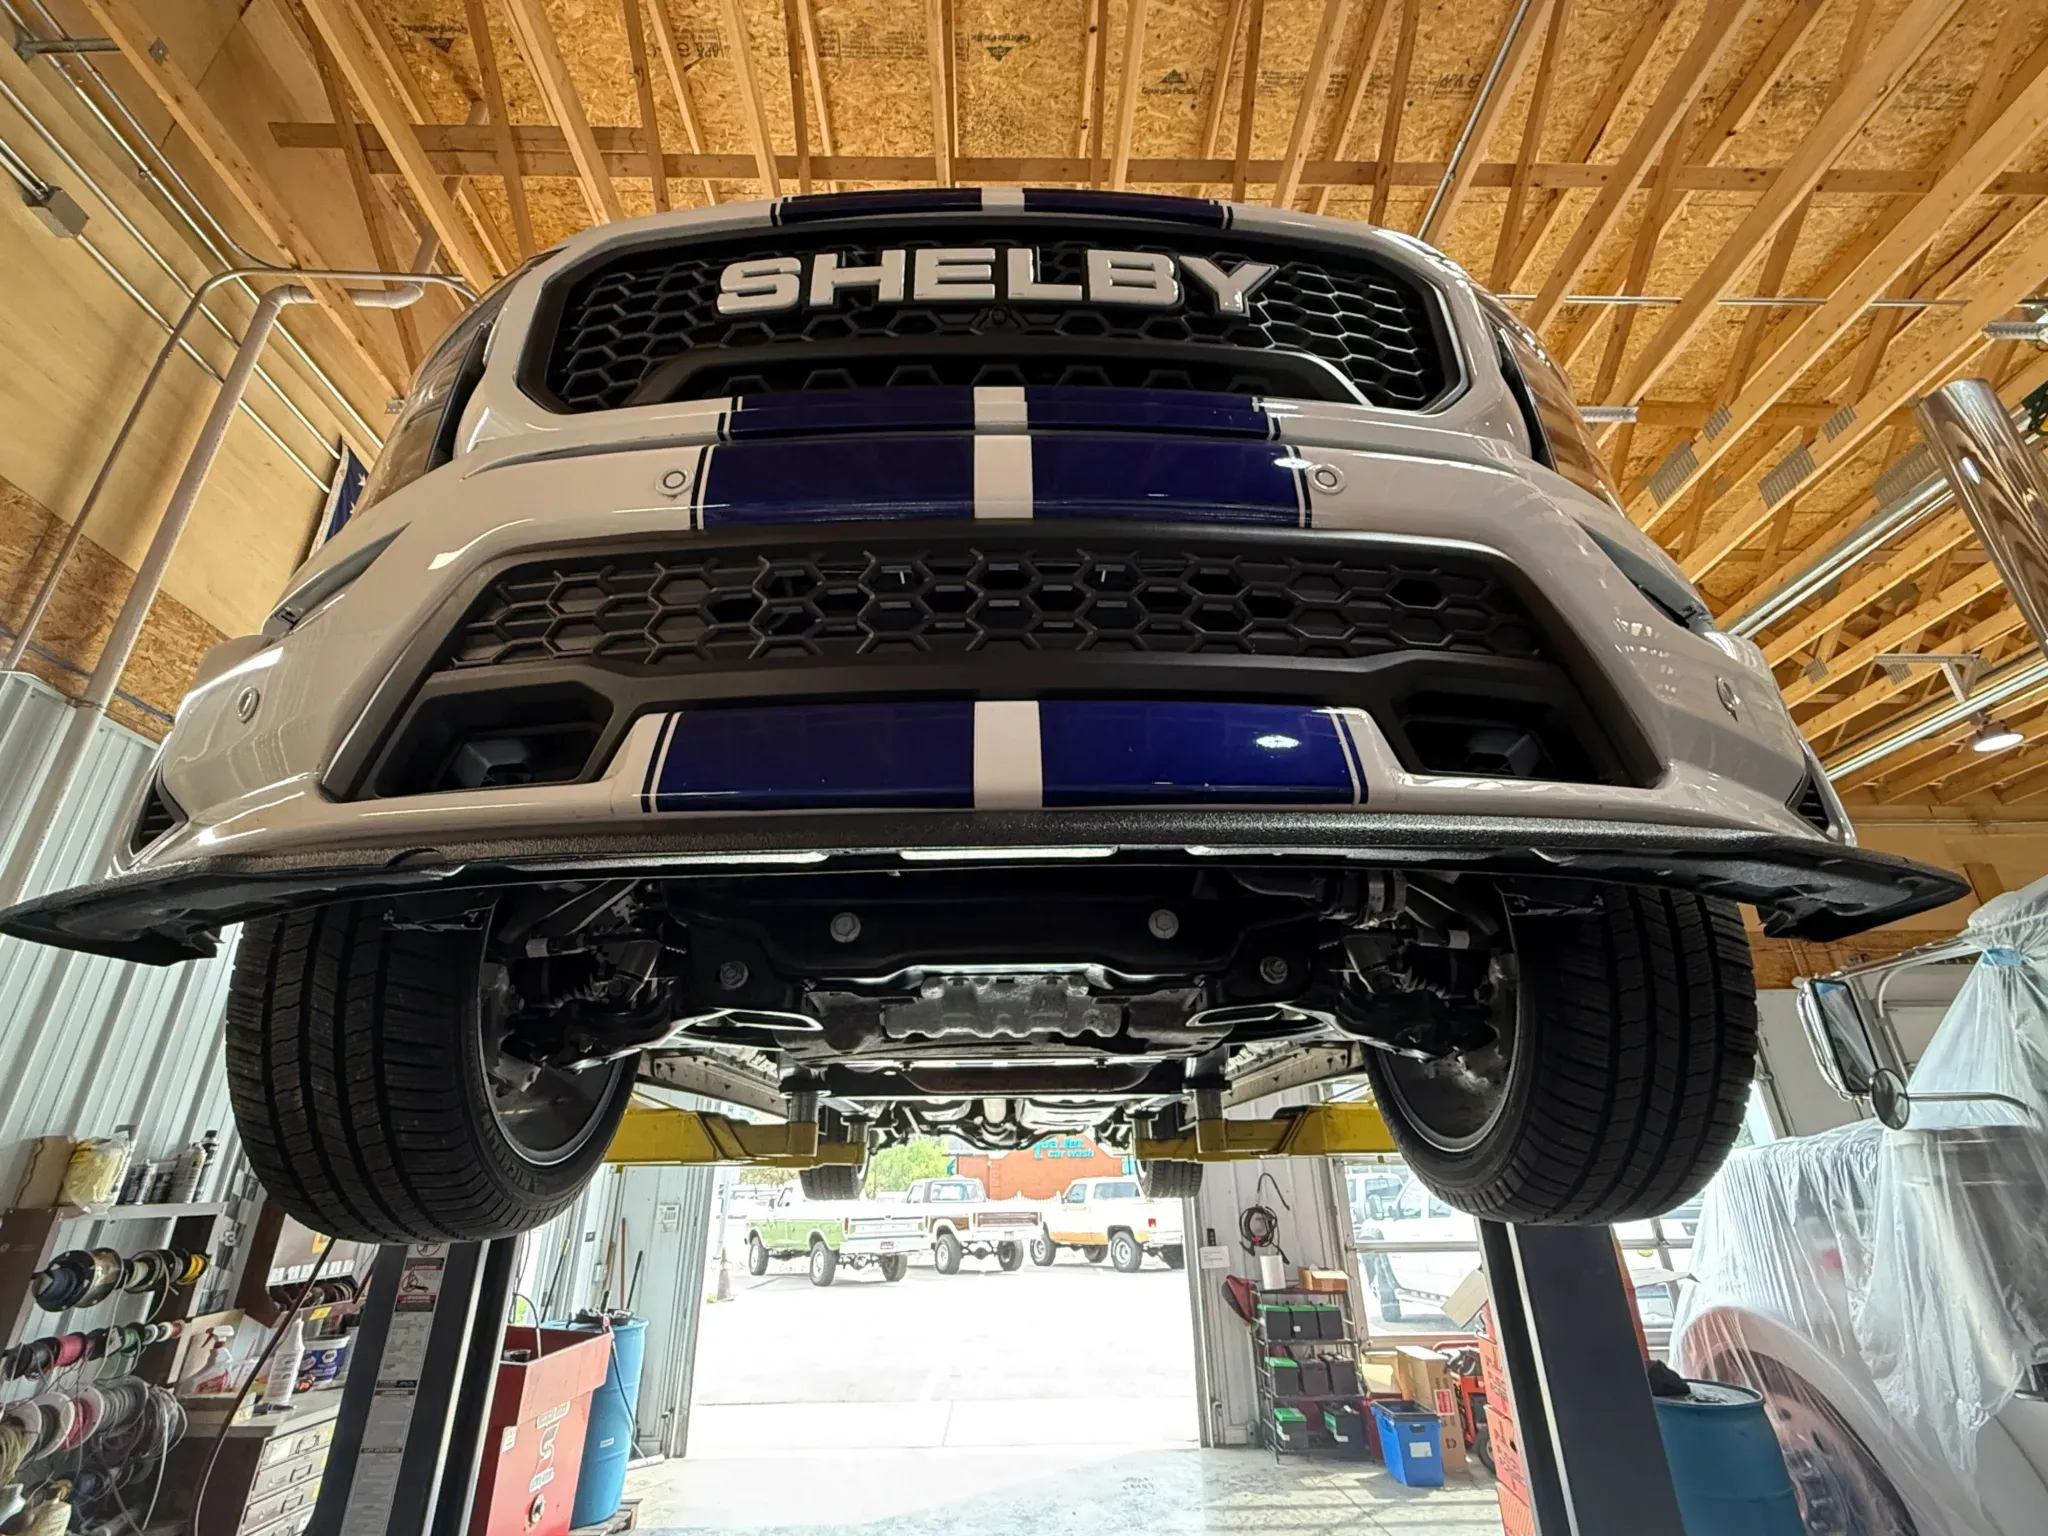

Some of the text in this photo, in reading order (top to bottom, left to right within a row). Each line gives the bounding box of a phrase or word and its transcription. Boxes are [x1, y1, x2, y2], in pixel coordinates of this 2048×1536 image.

[1141, 86, 1172, 96] Georgia
[717, 247, 1277, 315] SHELBY
[1067, 1148, 1094, 1158] wash
